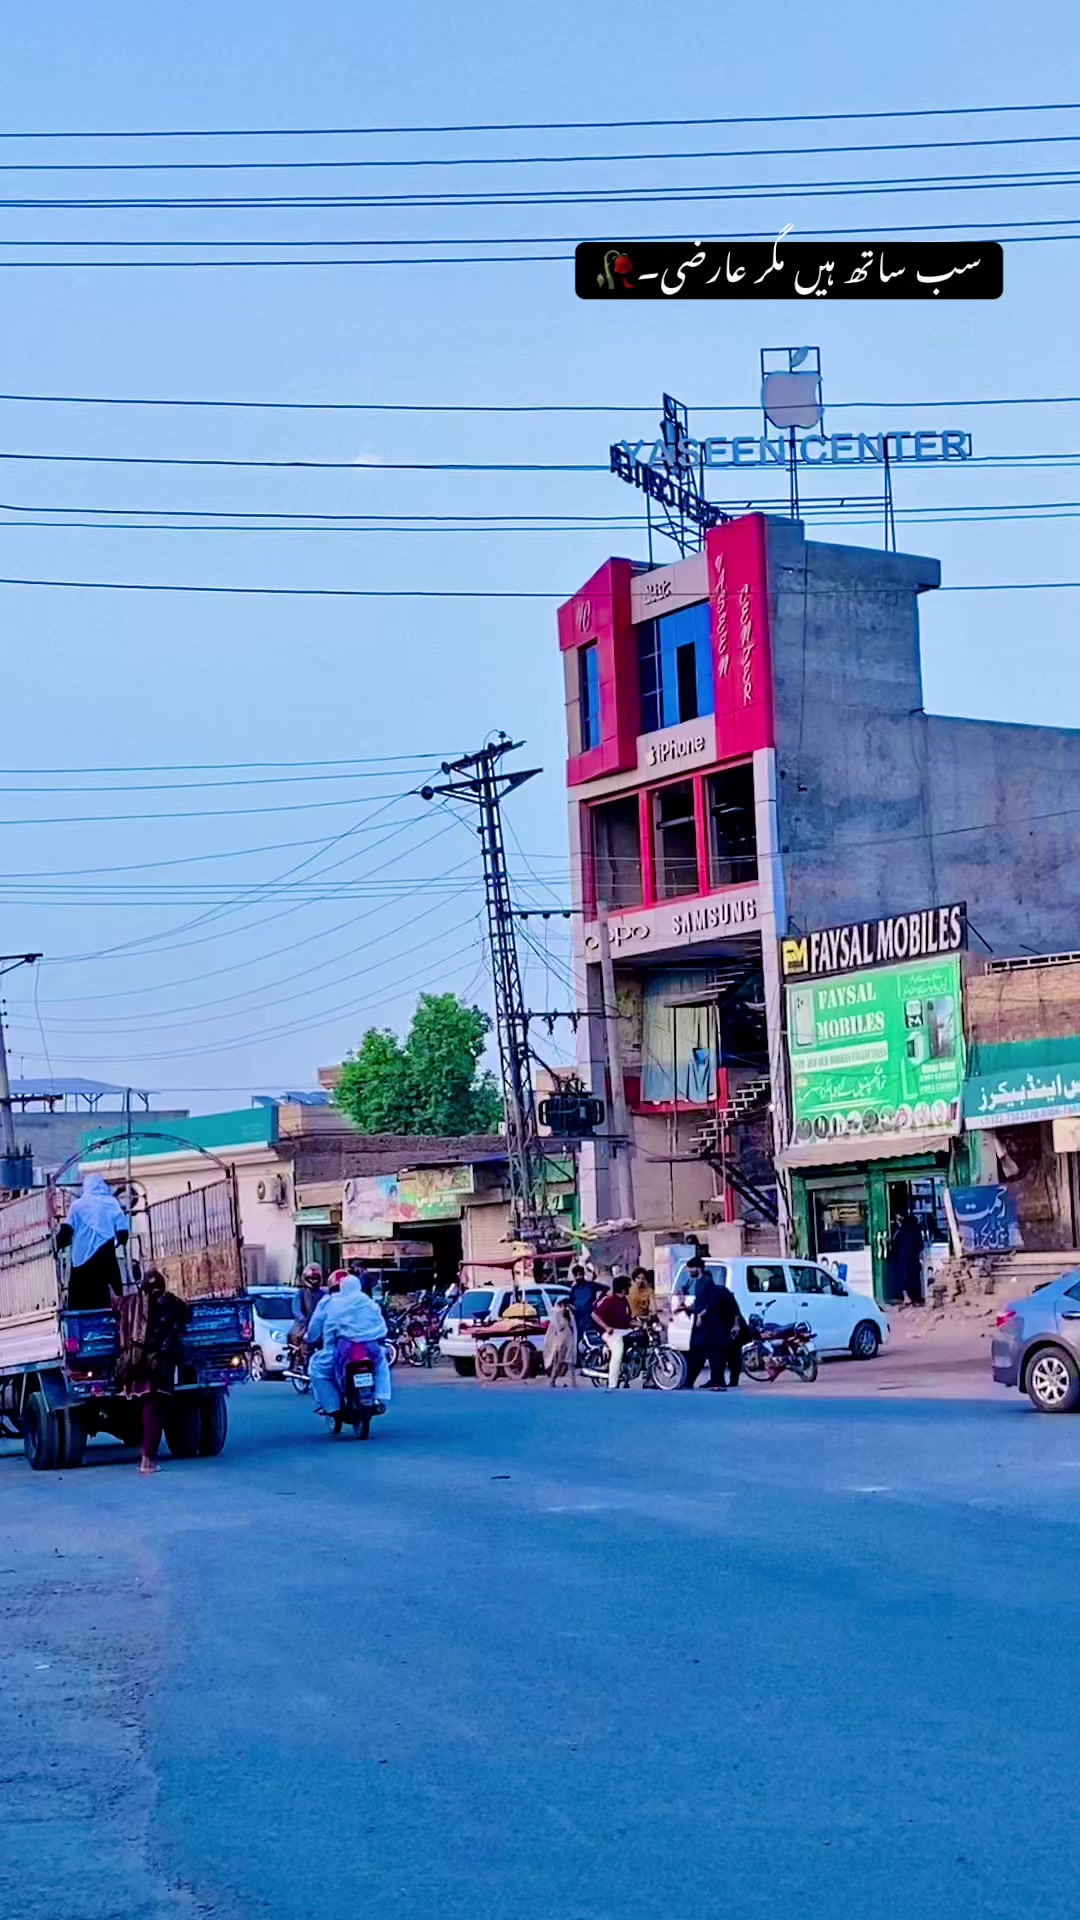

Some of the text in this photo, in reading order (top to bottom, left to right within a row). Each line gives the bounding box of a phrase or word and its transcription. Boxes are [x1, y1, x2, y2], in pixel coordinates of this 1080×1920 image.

[619, 429, 970, 468] YASEEN CENTER
[671, 898, 757, 936] SAMSUNG
[810, 906, 962, 974] FAYSAL MOBILES
[817, 982, 877, 1010] FAYSAL
[816, 1011, 885, 1040] MOBILES
